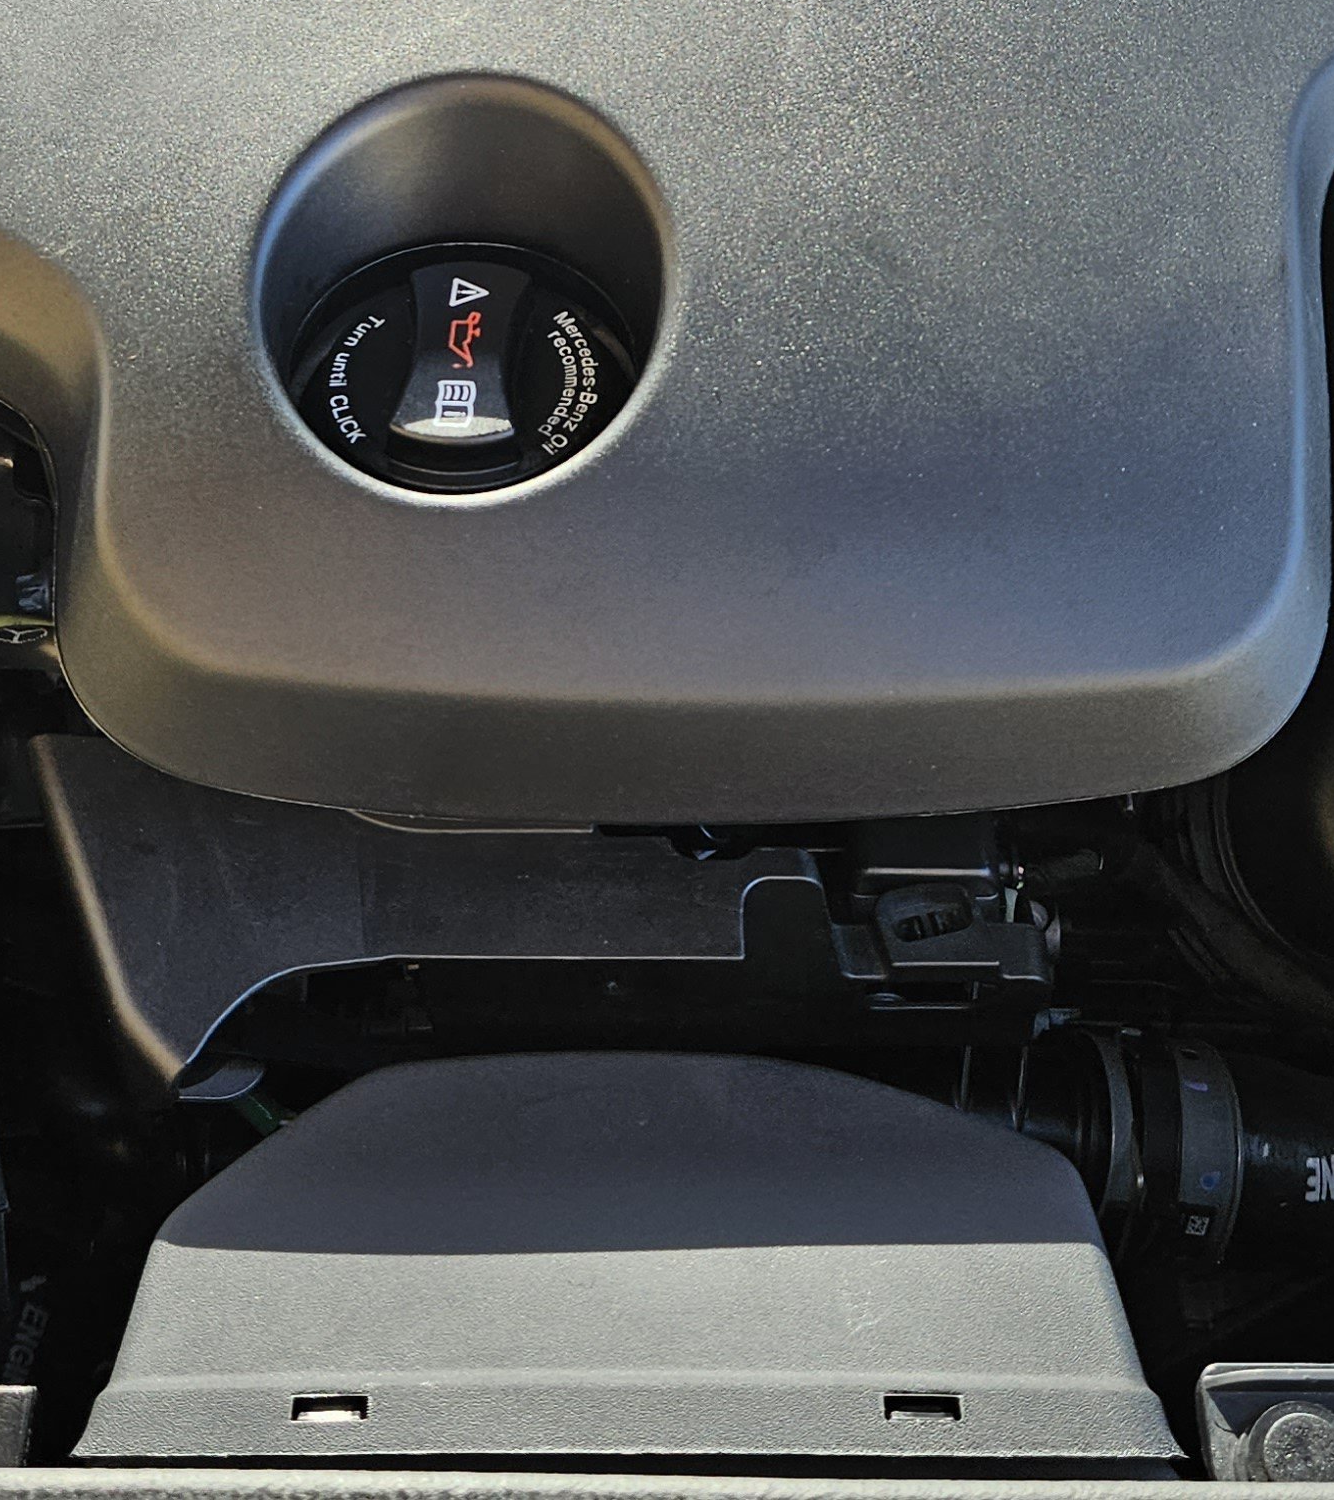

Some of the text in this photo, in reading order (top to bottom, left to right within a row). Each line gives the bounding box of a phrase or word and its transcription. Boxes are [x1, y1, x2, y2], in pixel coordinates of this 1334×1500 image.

[329, 315, 386, 444] Turn until CLICK
[537, 330, 578, 437] recommended
[542, 311, 599, 456] Mercedes-Benz Oil
